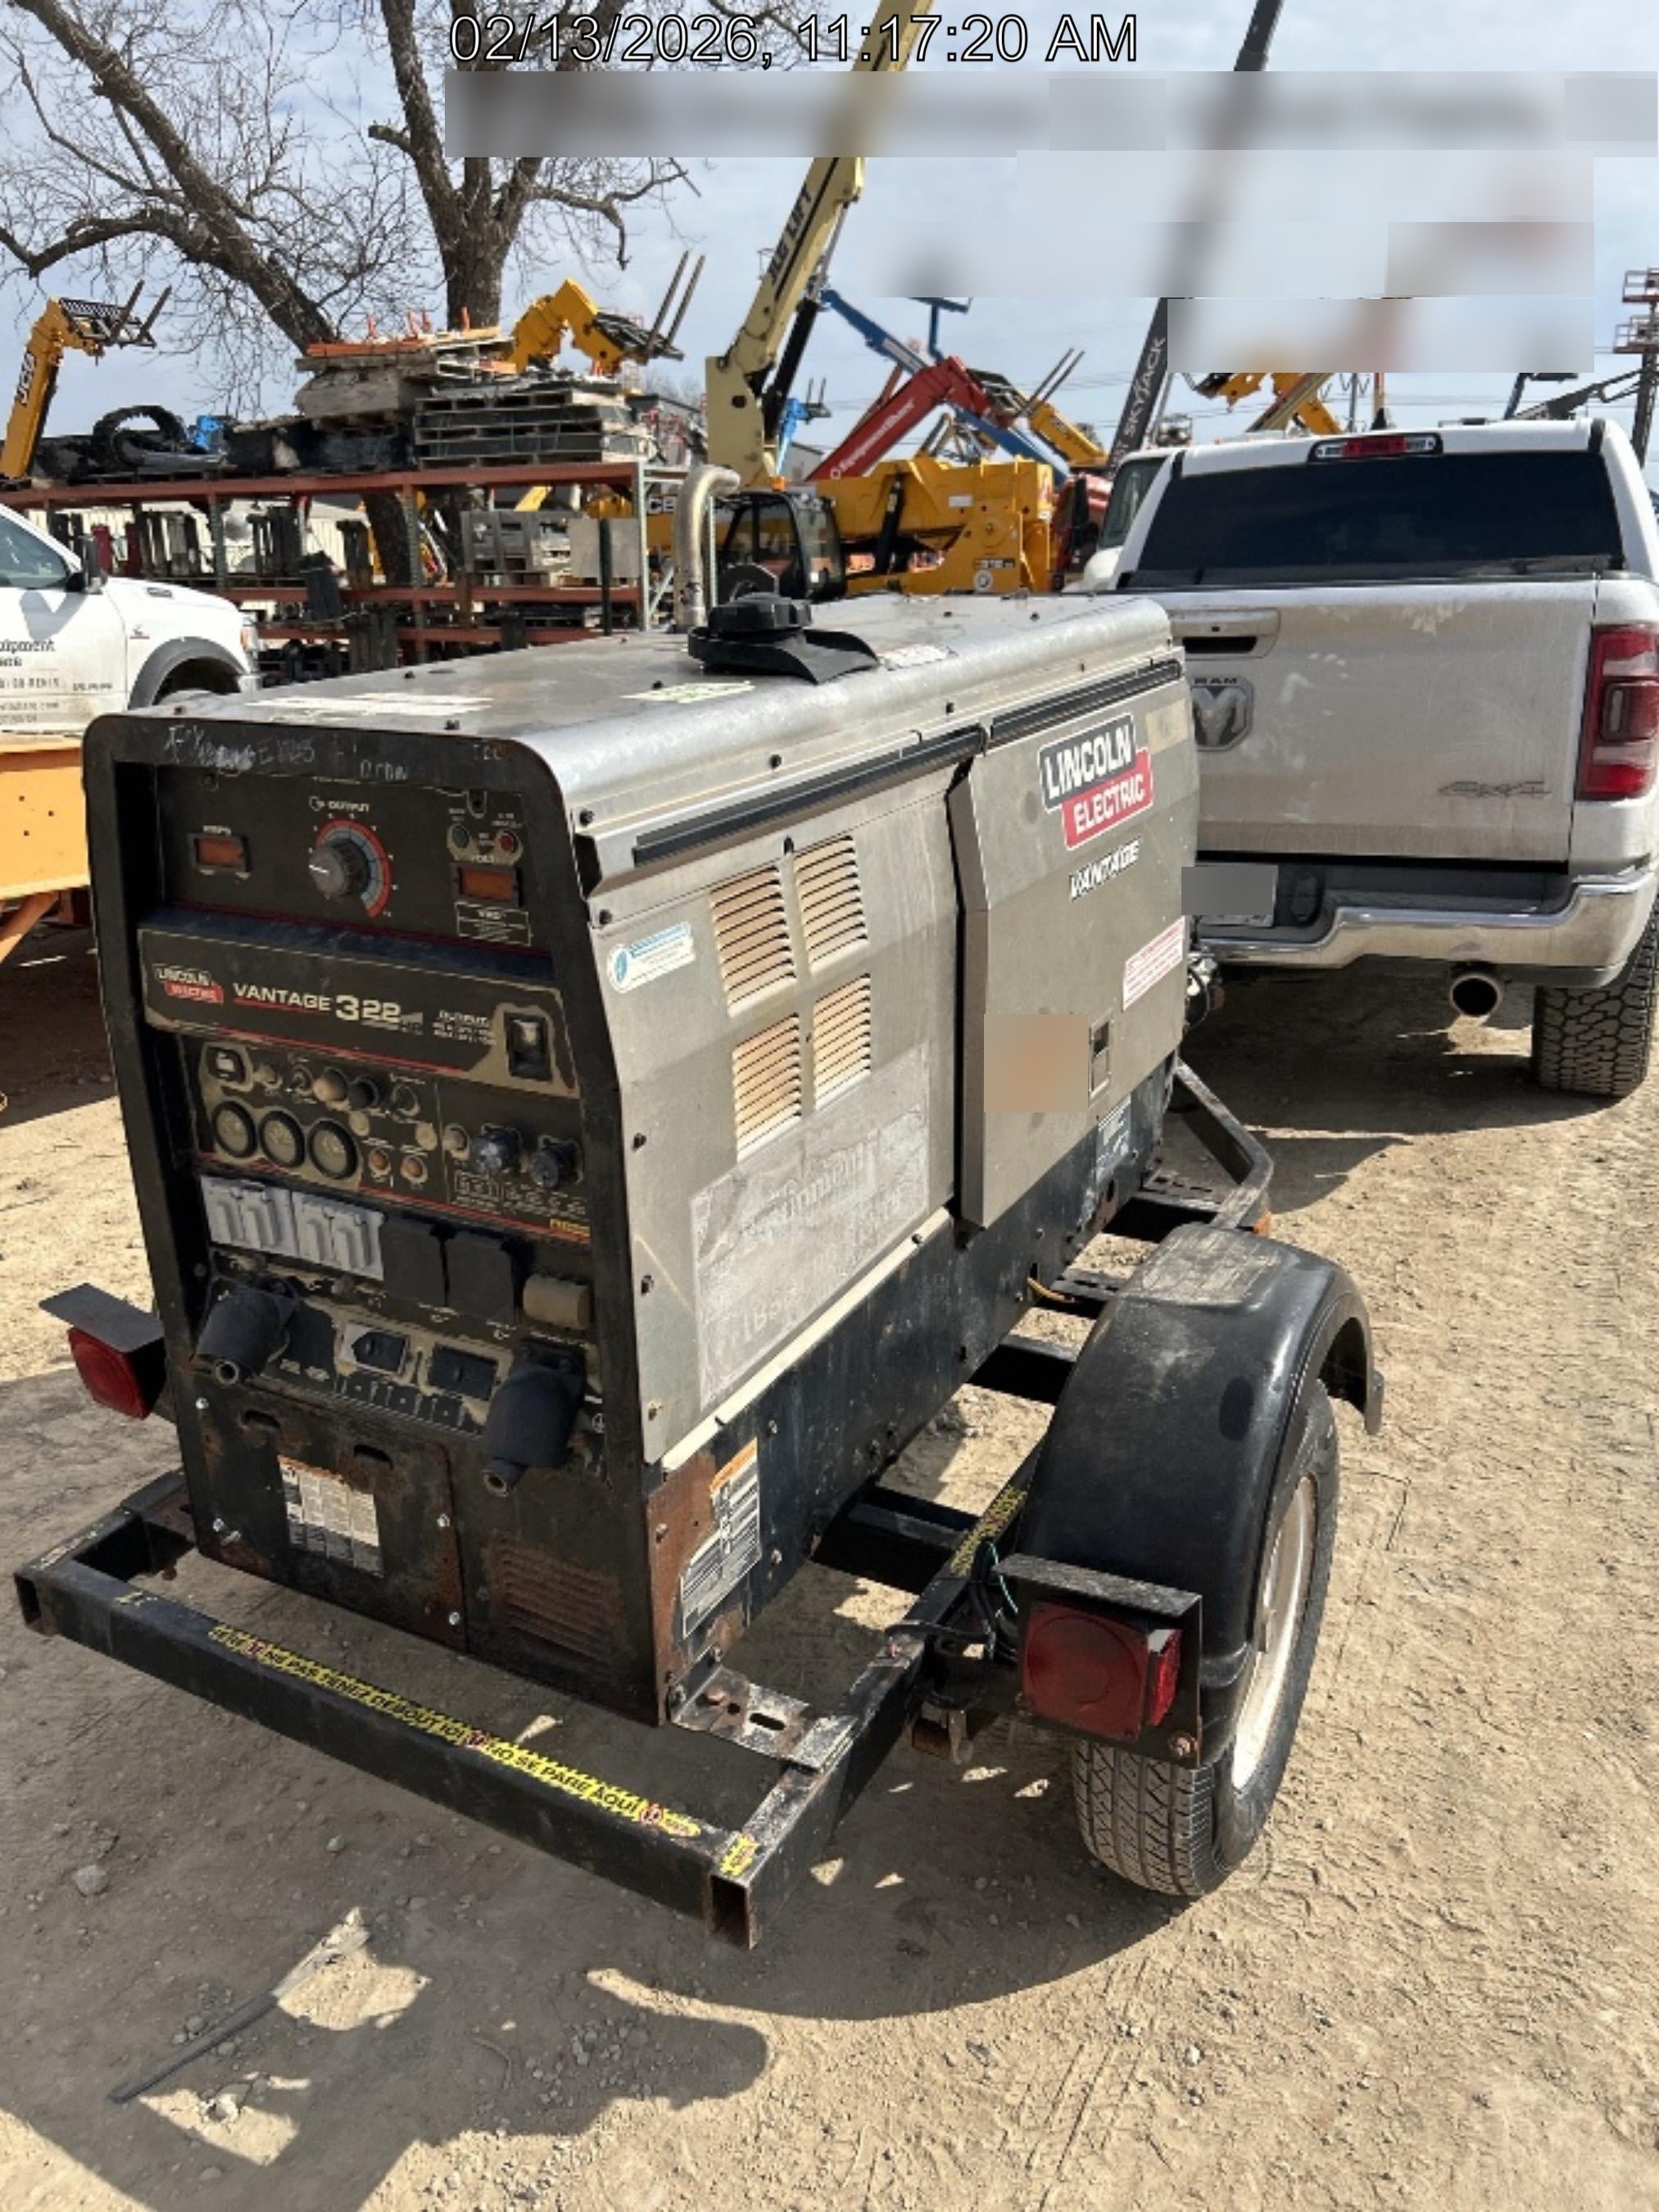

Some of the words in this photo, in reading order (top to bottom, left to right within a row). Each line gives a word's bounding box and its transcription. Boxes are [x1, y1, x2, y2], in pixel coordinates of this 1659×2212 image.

[784, 183, 812, 241] LIFT
[1123, 337, 1167, 437] SKYJACK
[1044, 723, 1132, 800] LINCOLN
[1072, 773, 1145, 836] ELECTRIC
[1069, 836, 1142, 902] VANTAGE
[156, 967, 211, 986] LINCOLN
[233, 982, 331, 1012] VANTAGE
[335, 994, 401, 1023] 322
[540, 1765, 592, 1794] PARE
